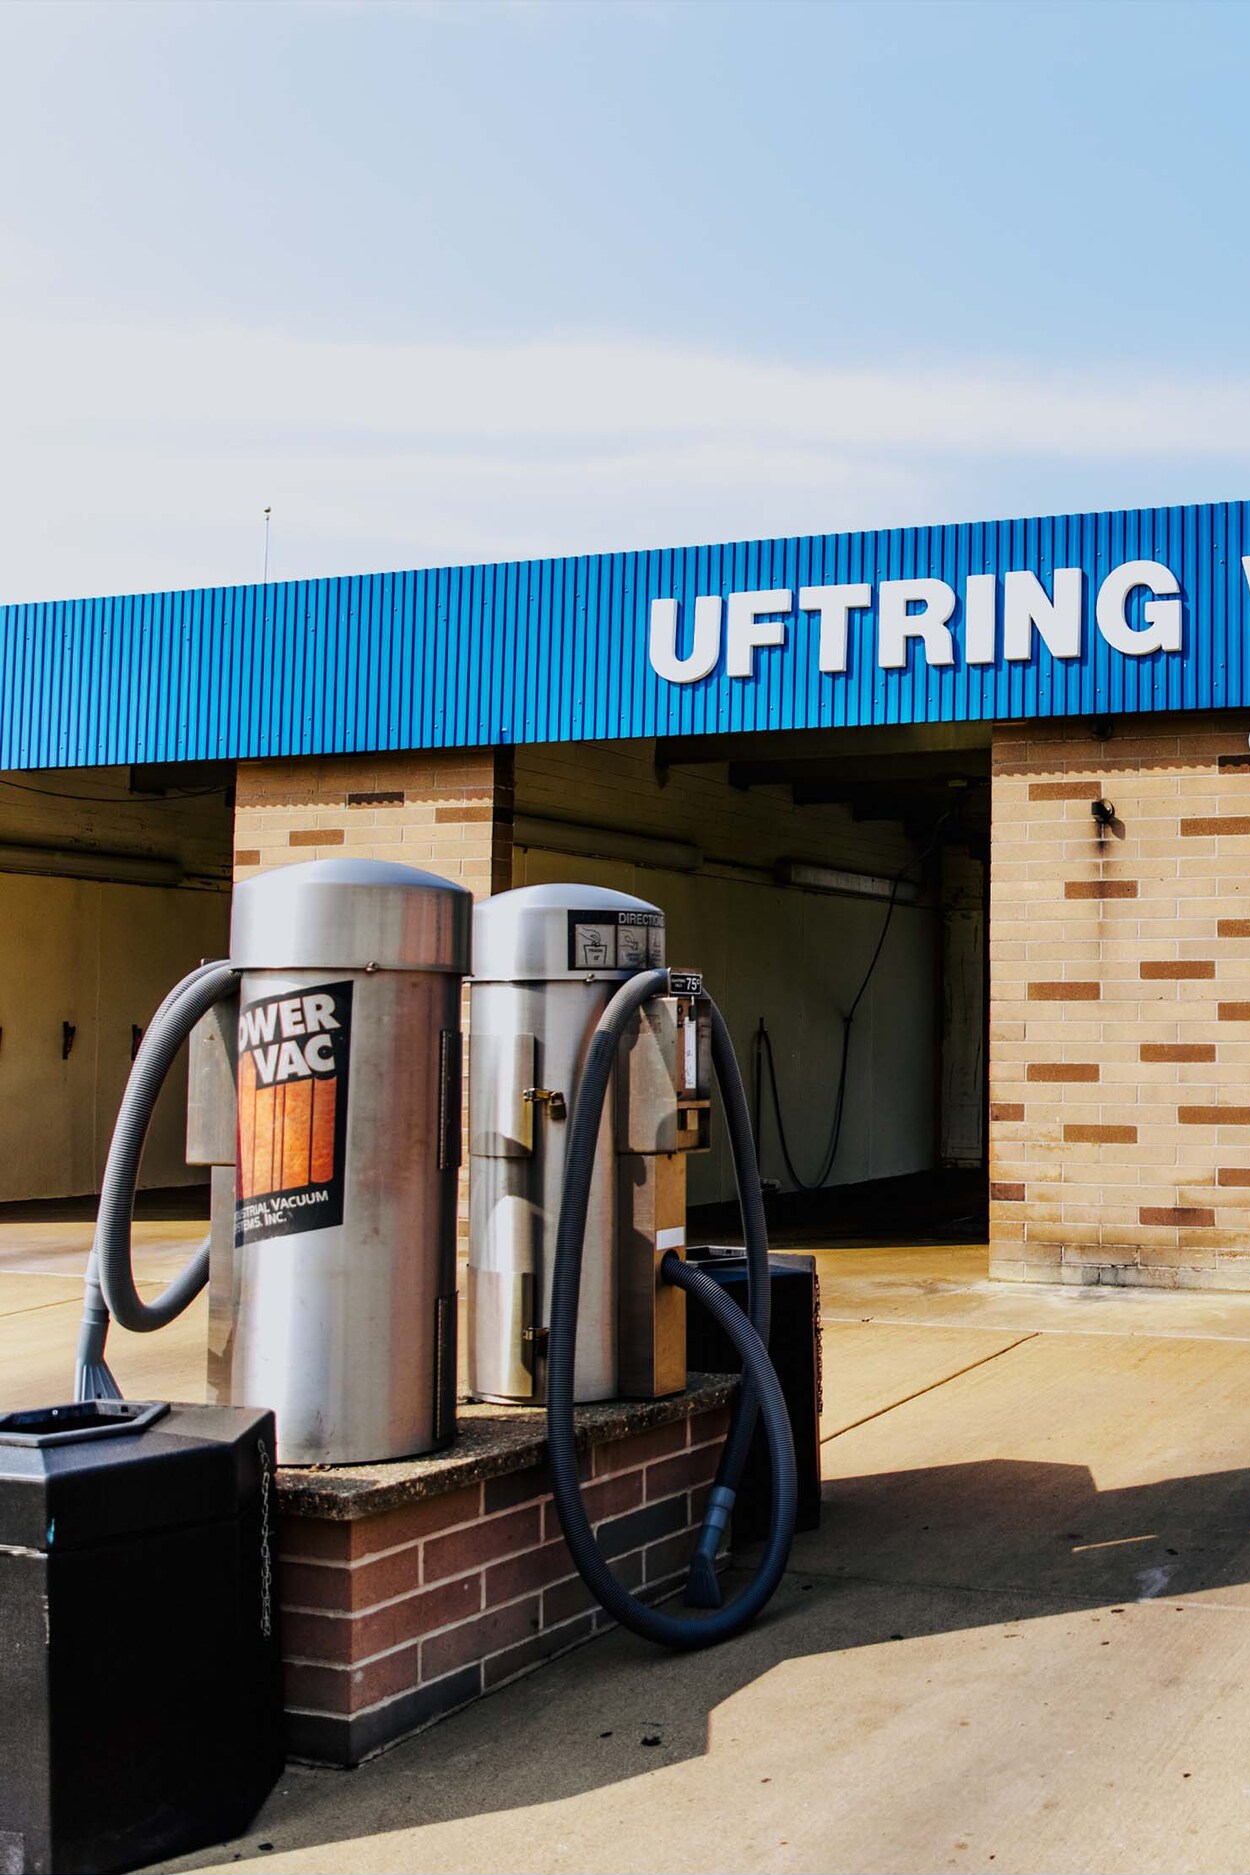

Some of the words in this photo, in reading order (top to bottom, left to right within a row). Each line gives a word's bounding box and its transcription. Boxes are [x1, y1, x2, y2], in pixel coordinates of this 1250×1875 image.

[649, 559, 1183, 684] UFTRING
[238, 993, 340, 1054] OWER
[253, 1034, 335, 1084] VAC
[265, 1212, 287, 1226] INC.
[270, 1190, 328, 1211] VACUUM
